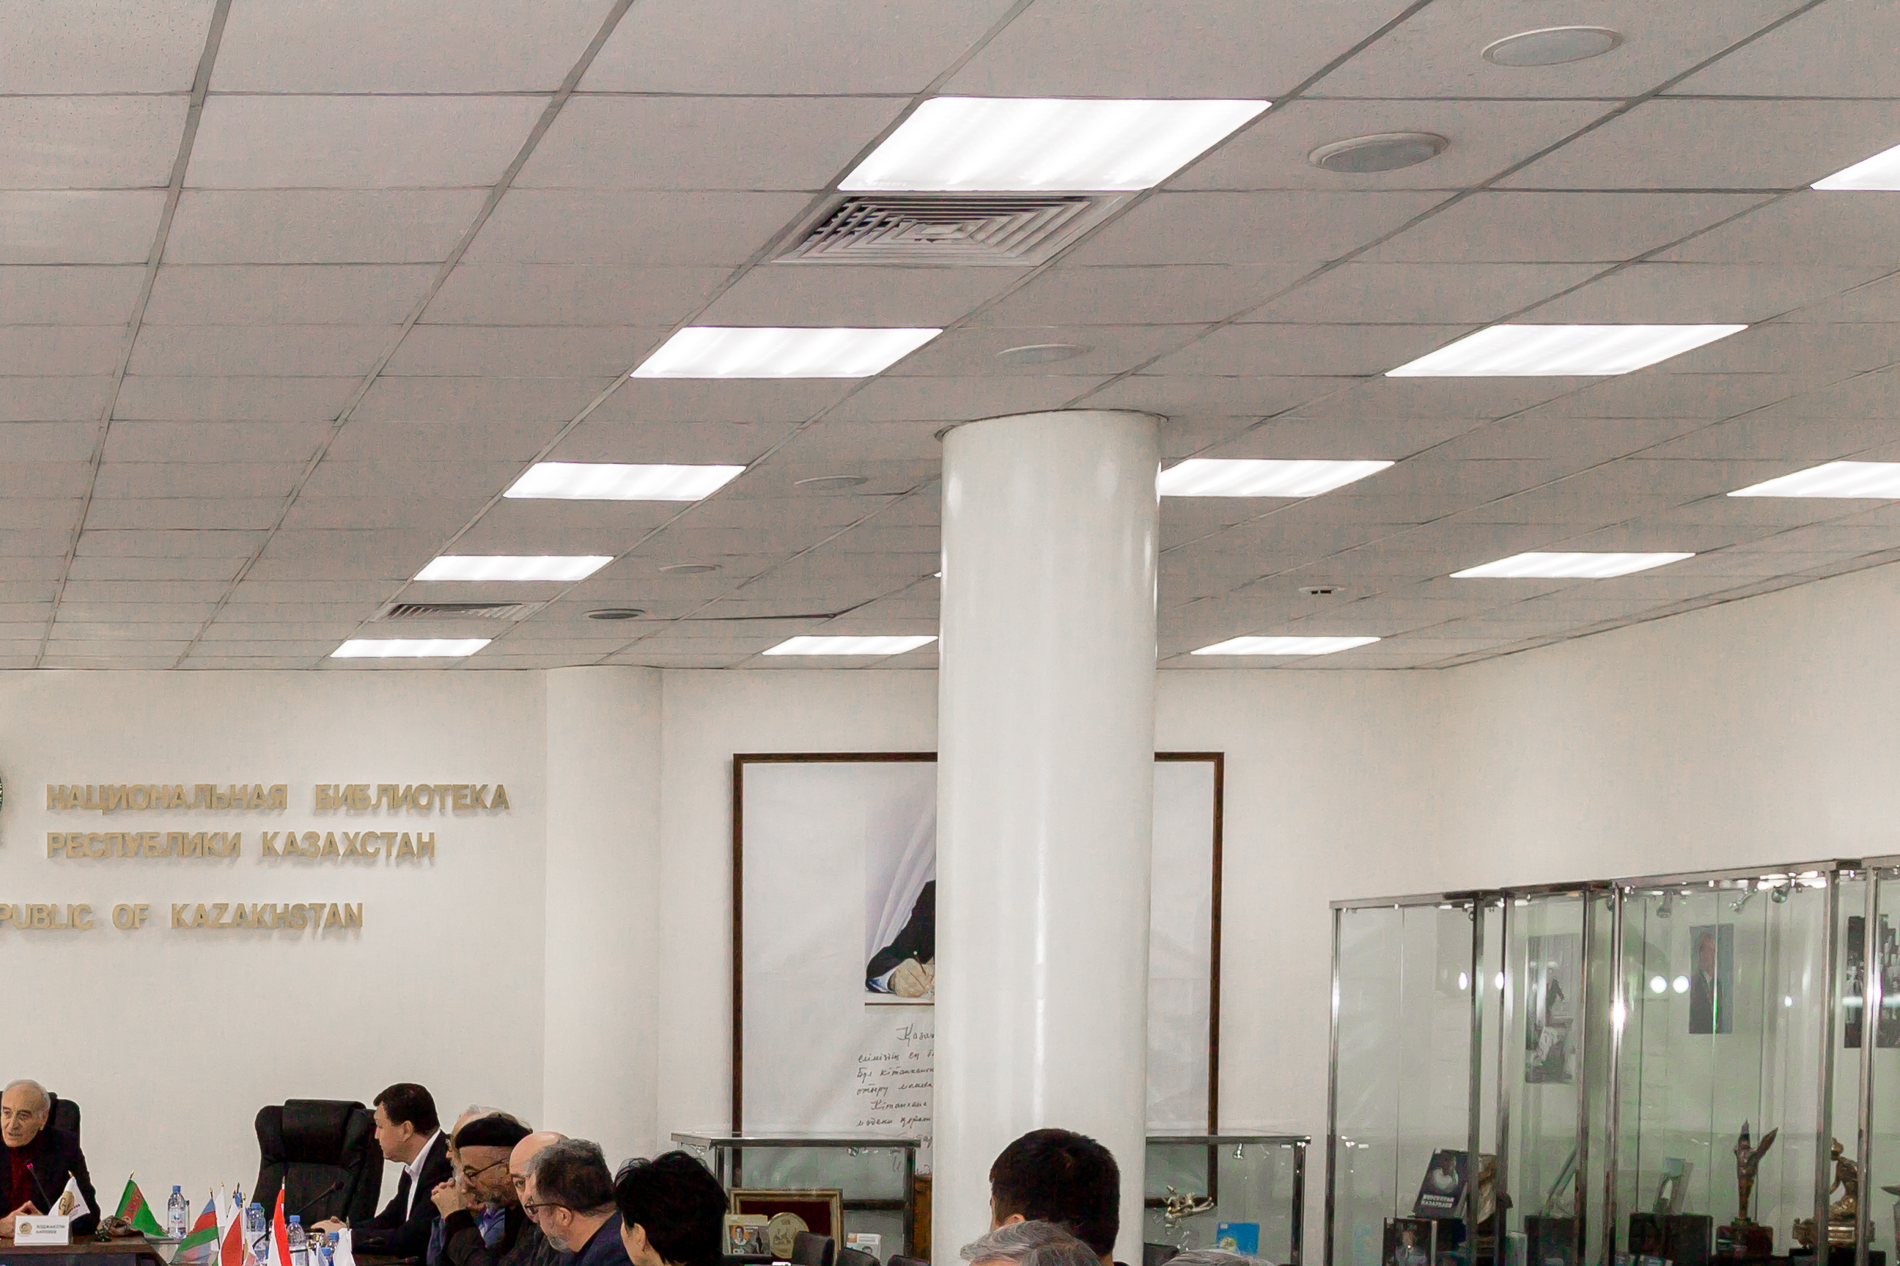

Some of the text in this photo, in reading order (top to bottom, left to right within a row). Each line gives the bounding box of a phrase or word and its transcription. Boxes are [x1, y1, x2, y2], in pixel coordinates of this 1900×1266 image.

[46, 784, 510, 815] НАЦИОНАЛЬНАЯ БИБЛИОТЕКА
[46, 831, 435, 858] РЕСПУБЛИКИ КАЗАХСТАН
[111, 903, 149, 930] OF
[171, 903, 363, 930] KAZAKHSTAN
